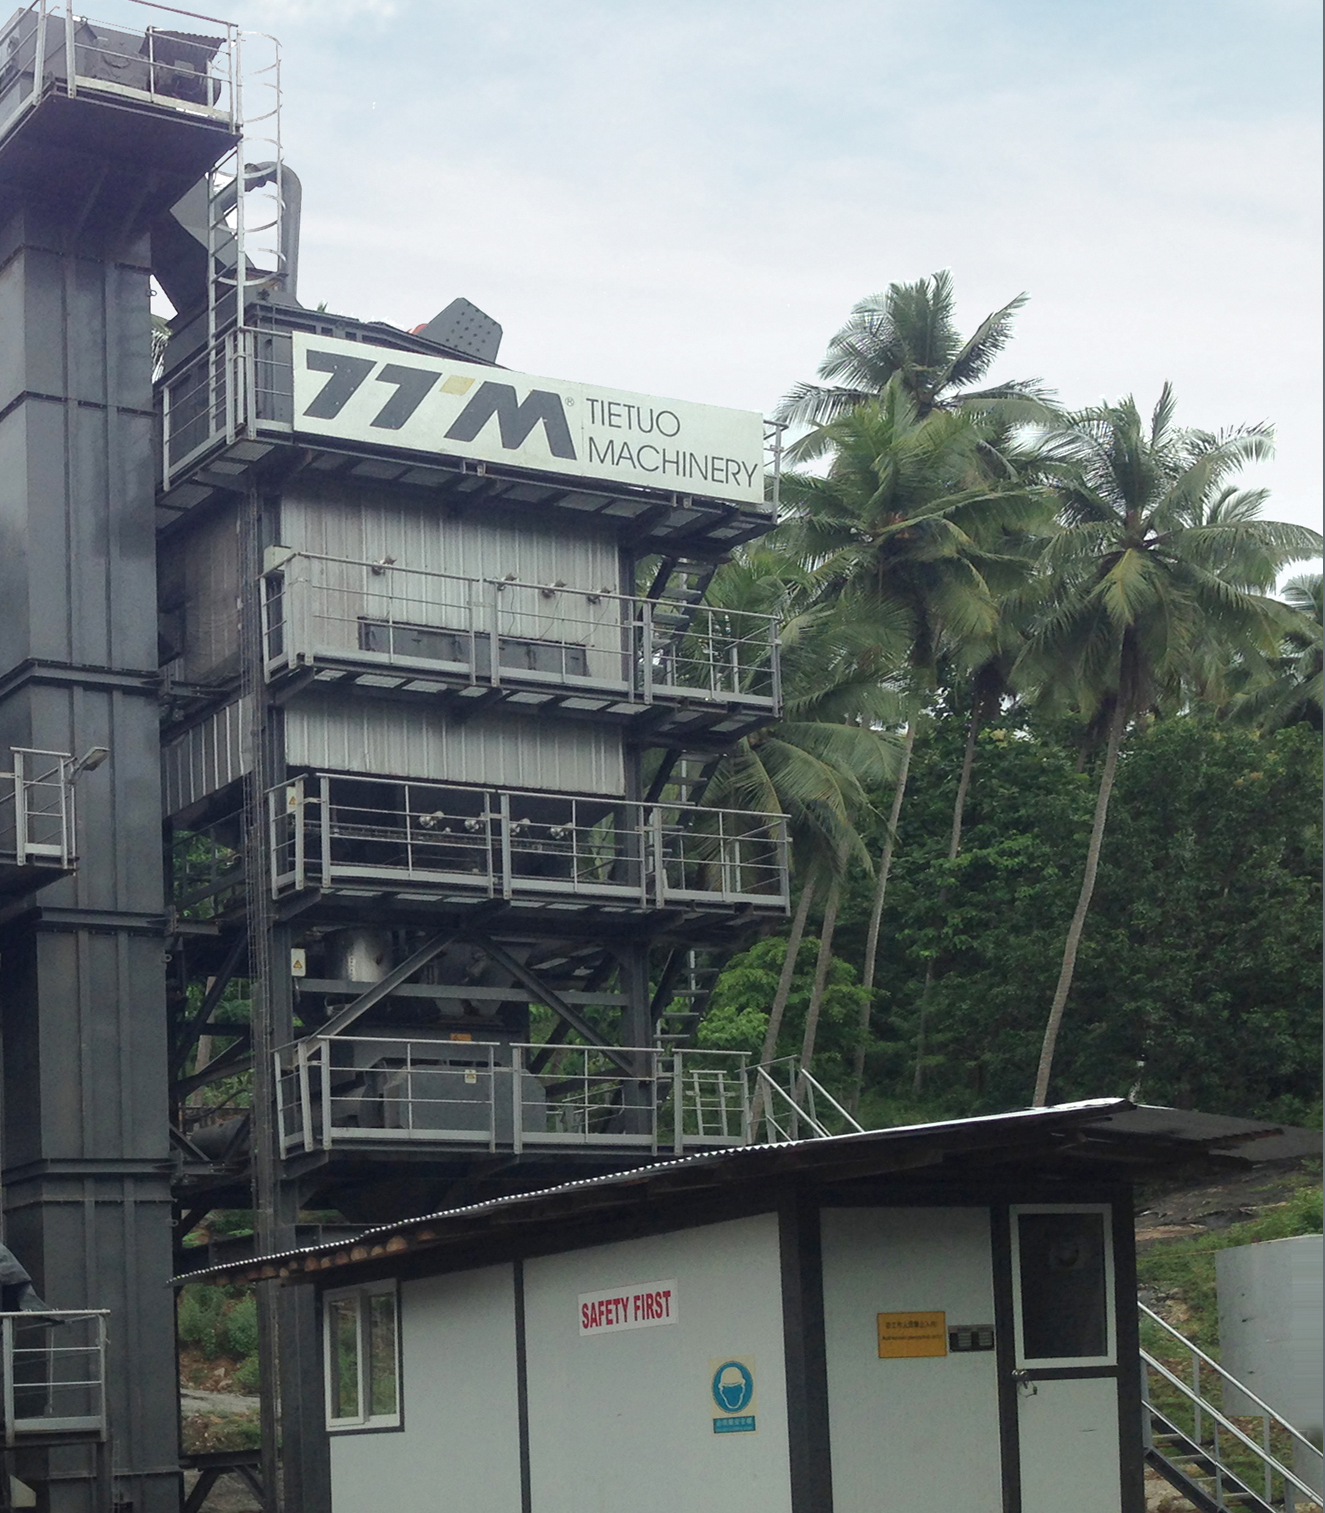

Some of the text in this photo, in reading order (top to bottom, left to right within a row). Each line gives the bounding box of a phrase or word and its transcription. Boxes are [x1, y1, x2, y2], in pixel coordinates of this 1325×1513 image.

[586, 398, 681, 437] TIETUO
[589, 436, 759, 488] MACHINERY
[582, 1290, 672, 1329] SAFETY FIRST
